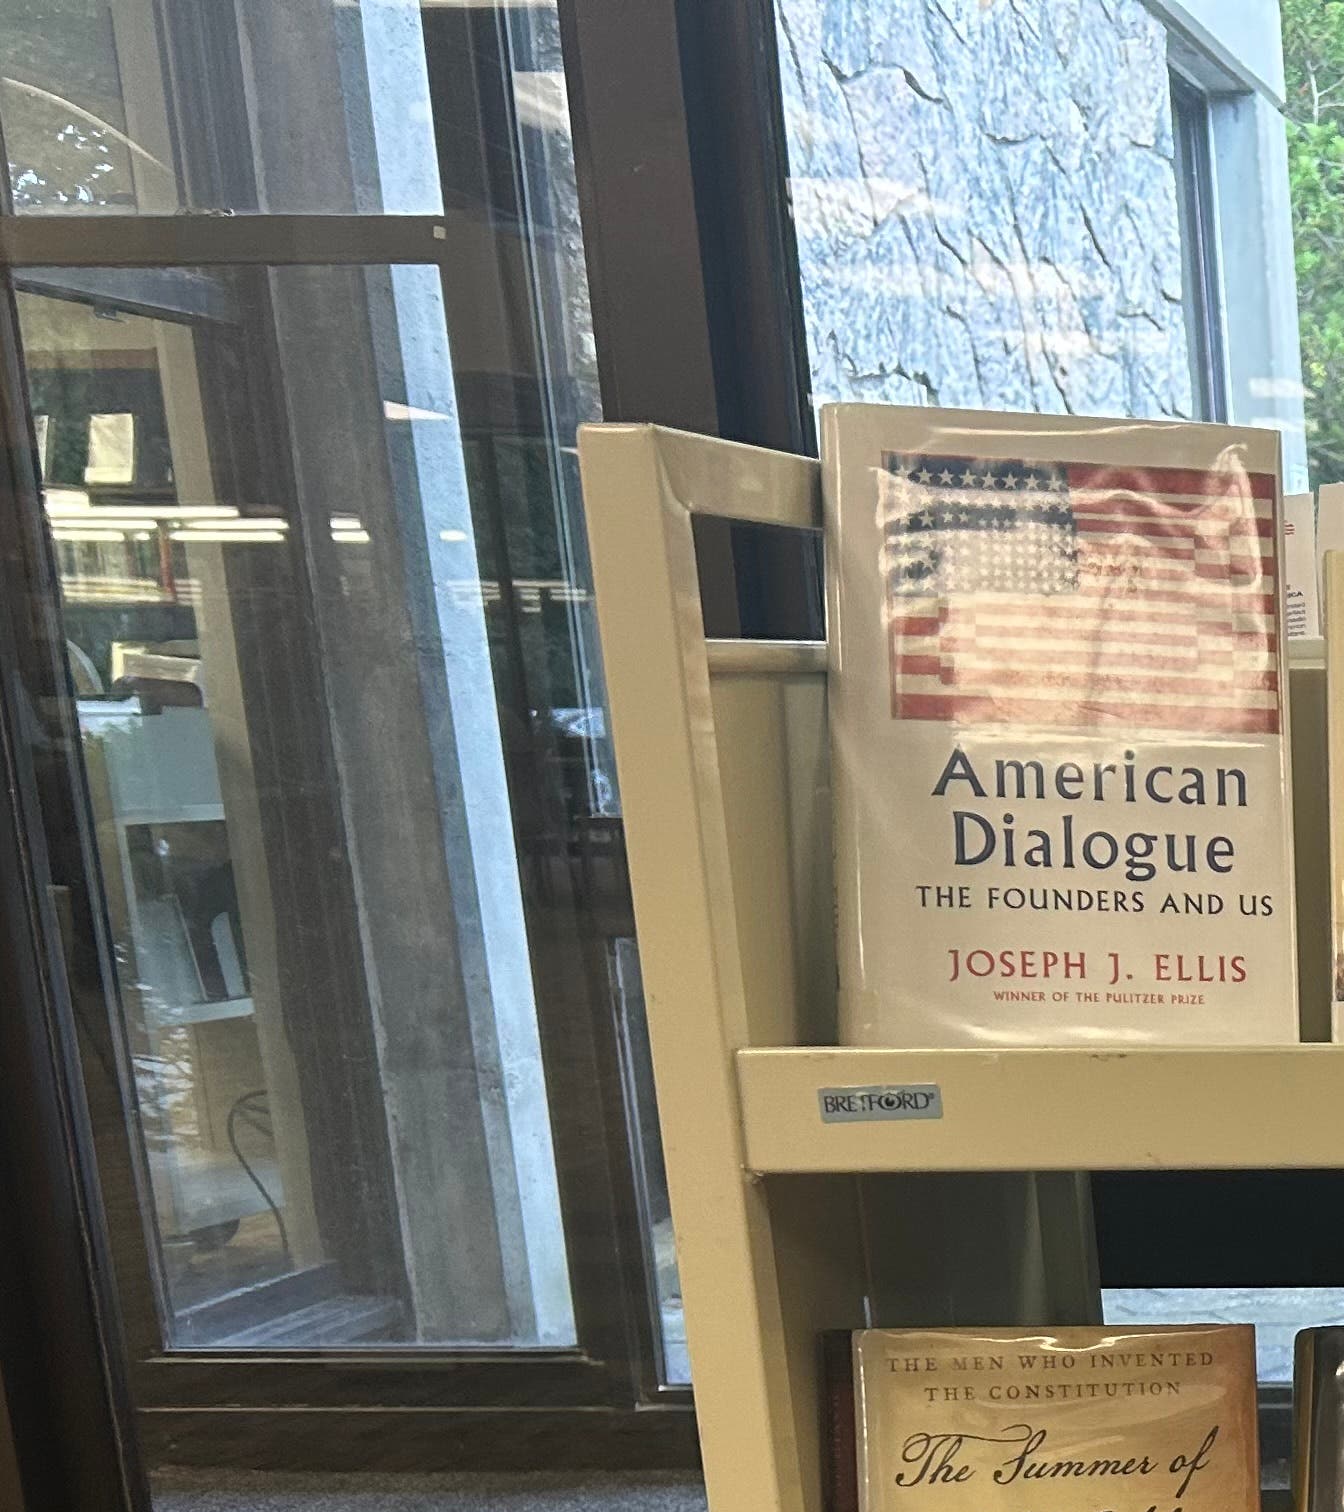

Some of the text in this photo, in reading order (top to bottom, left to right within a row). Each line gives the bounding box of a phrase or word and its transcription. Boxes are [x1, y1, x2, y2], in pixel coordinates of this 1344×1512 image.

[931, 743, 1248, 807] American
[952, 810, 1235, 882] Dialogue
[916, 886, 1274, 917] THE FOUNDERS AND US
[948, 949, 1248, 985] JOSEPH J. ELLIS
[993, 991, 1205, 1005] WINNER OF THE PULITZER PRIZE
[886, 1352, 1214, 1373] THE MEN WHO INVENTED
[924, 1382, 1181, 1401] THE CONSTITUTION
[895, 1426, 1220, 1499] The Summer of
